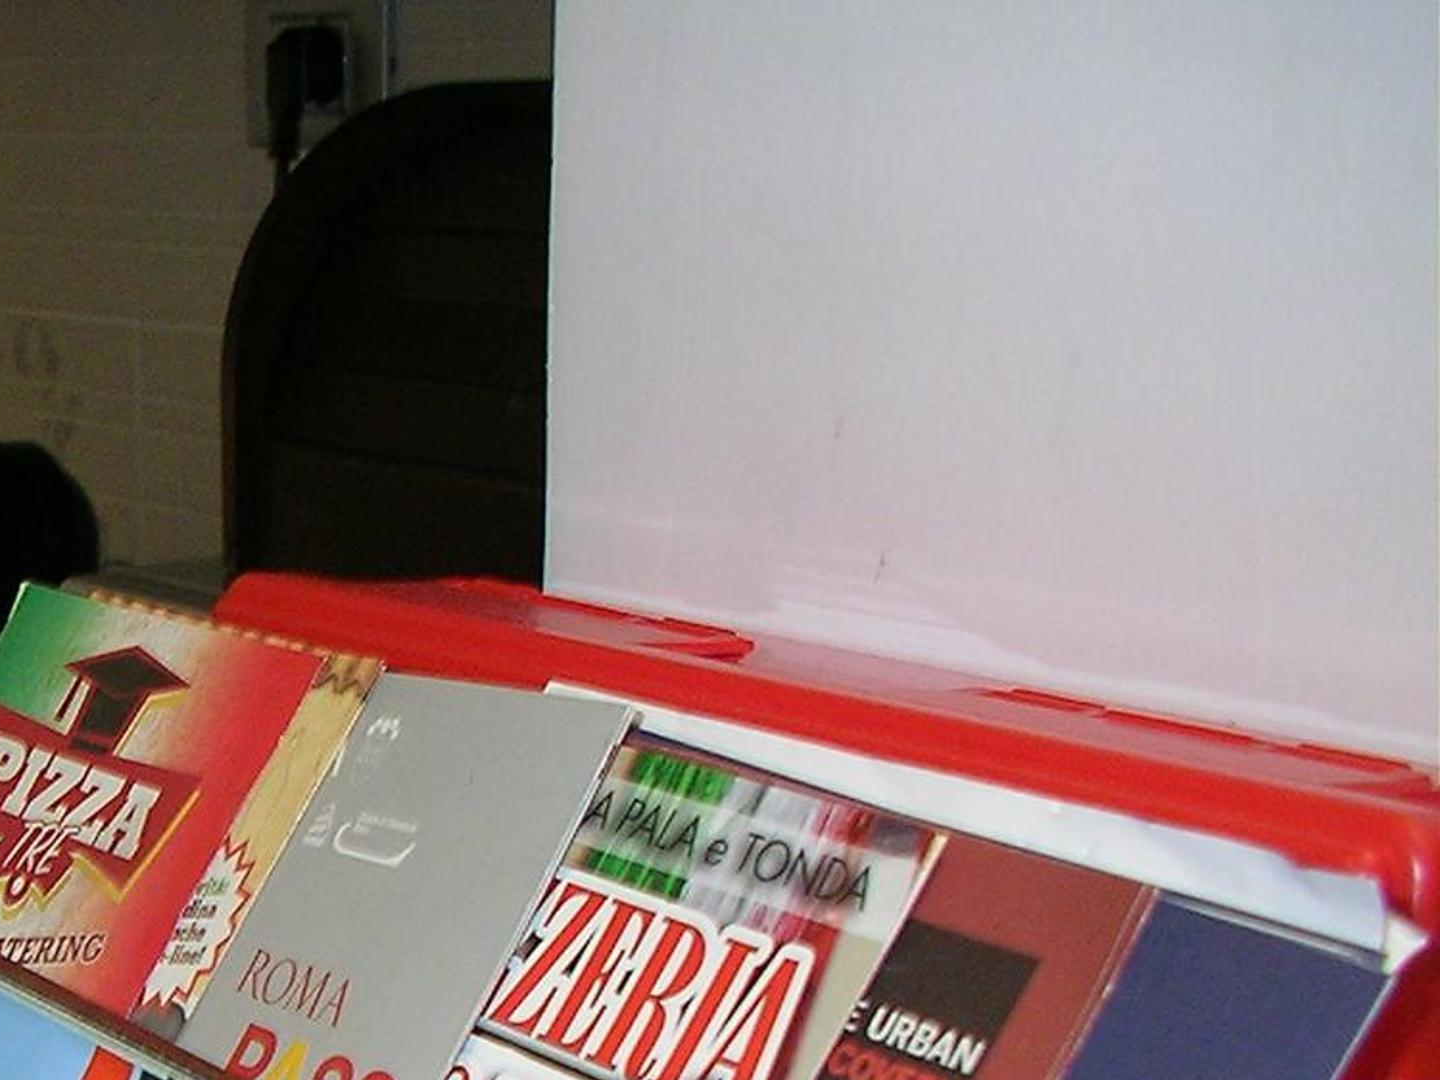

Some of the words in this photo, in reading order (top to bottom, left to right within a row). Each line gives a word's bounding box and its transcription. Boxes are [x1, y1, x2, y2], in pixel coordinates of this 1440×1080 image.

[615, 797, 702, 857] PALA
[703, 836, 729, 867] e
[738, 832, 872, 912] TONDA
[237, 949, 350, 1029] ROMA
[866, 1003, 987, 1076] URBAN
